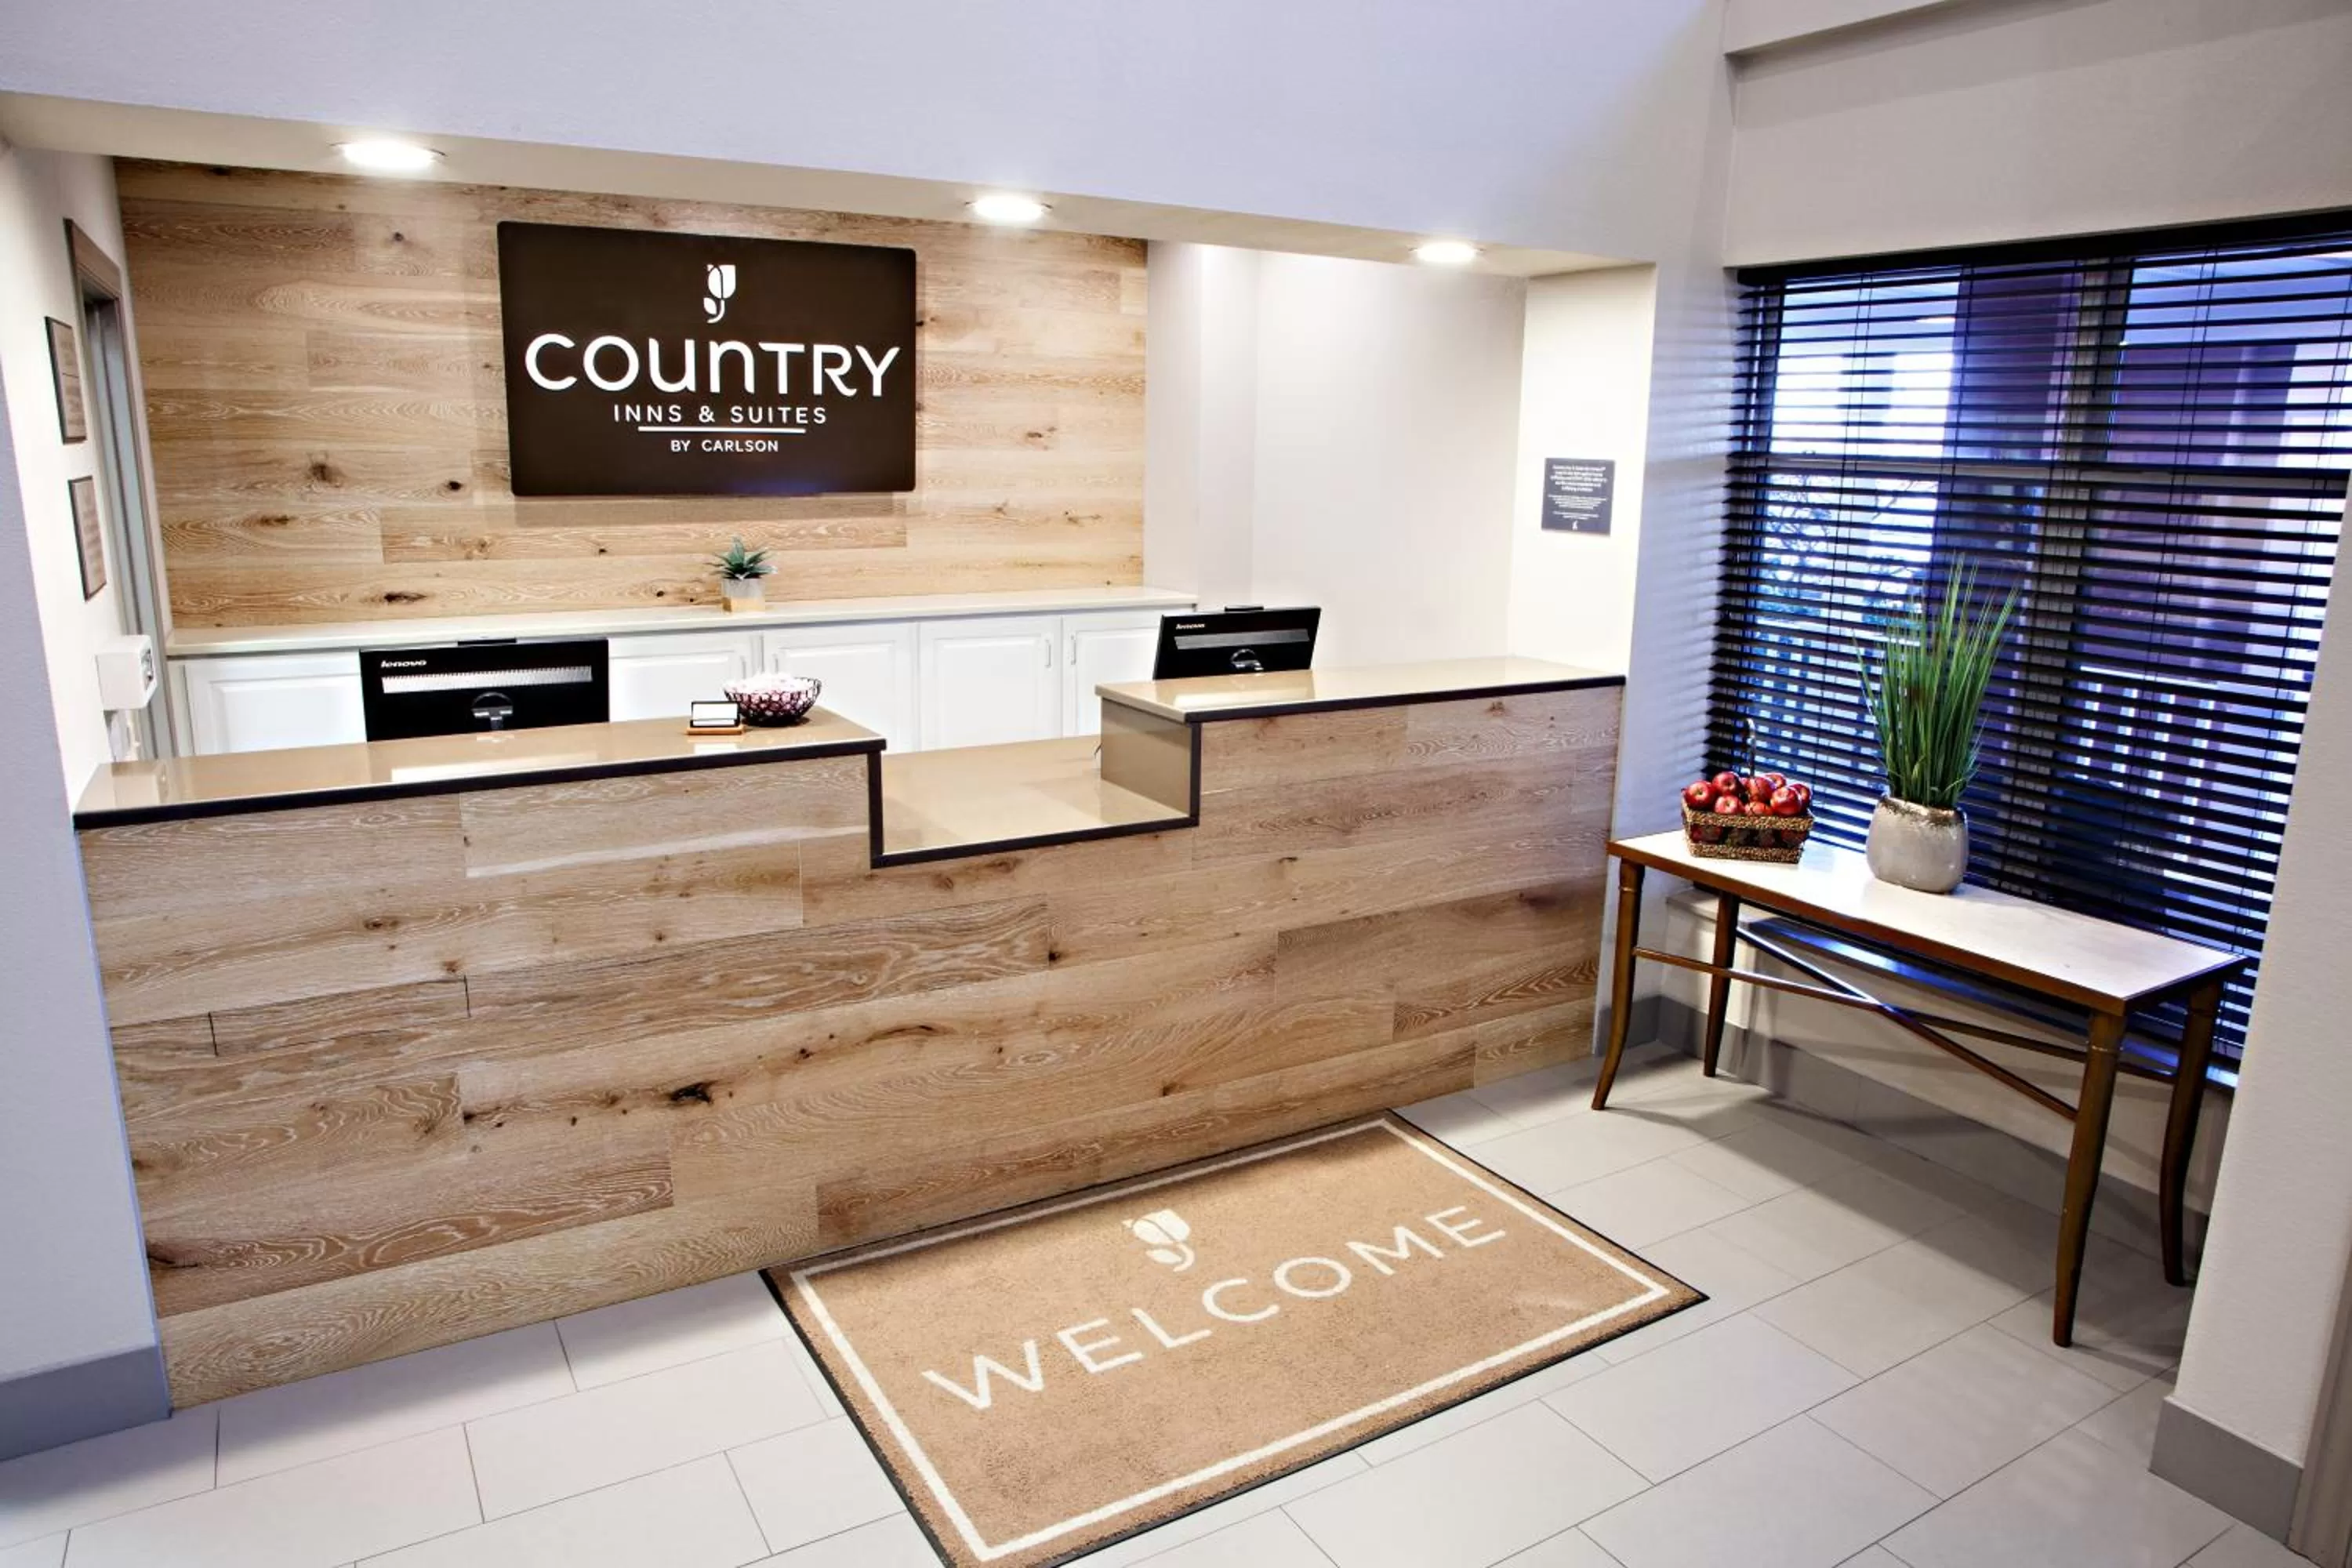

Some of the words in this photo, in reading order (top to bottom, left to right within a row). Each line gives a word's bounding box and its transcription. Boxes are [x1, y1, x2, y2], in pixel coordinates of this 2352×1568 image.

[614, 404, 682, 423] INNS
[699, 405, 716, 423] &
[731, 405, 826, 424] SUITES
[670, 439, 691, 452] BY
[702, 439, 779, 452] CARLSON
[380, 659, 427, 668] lenovo
[921, 1205, 1506, 1410] WELCOME
